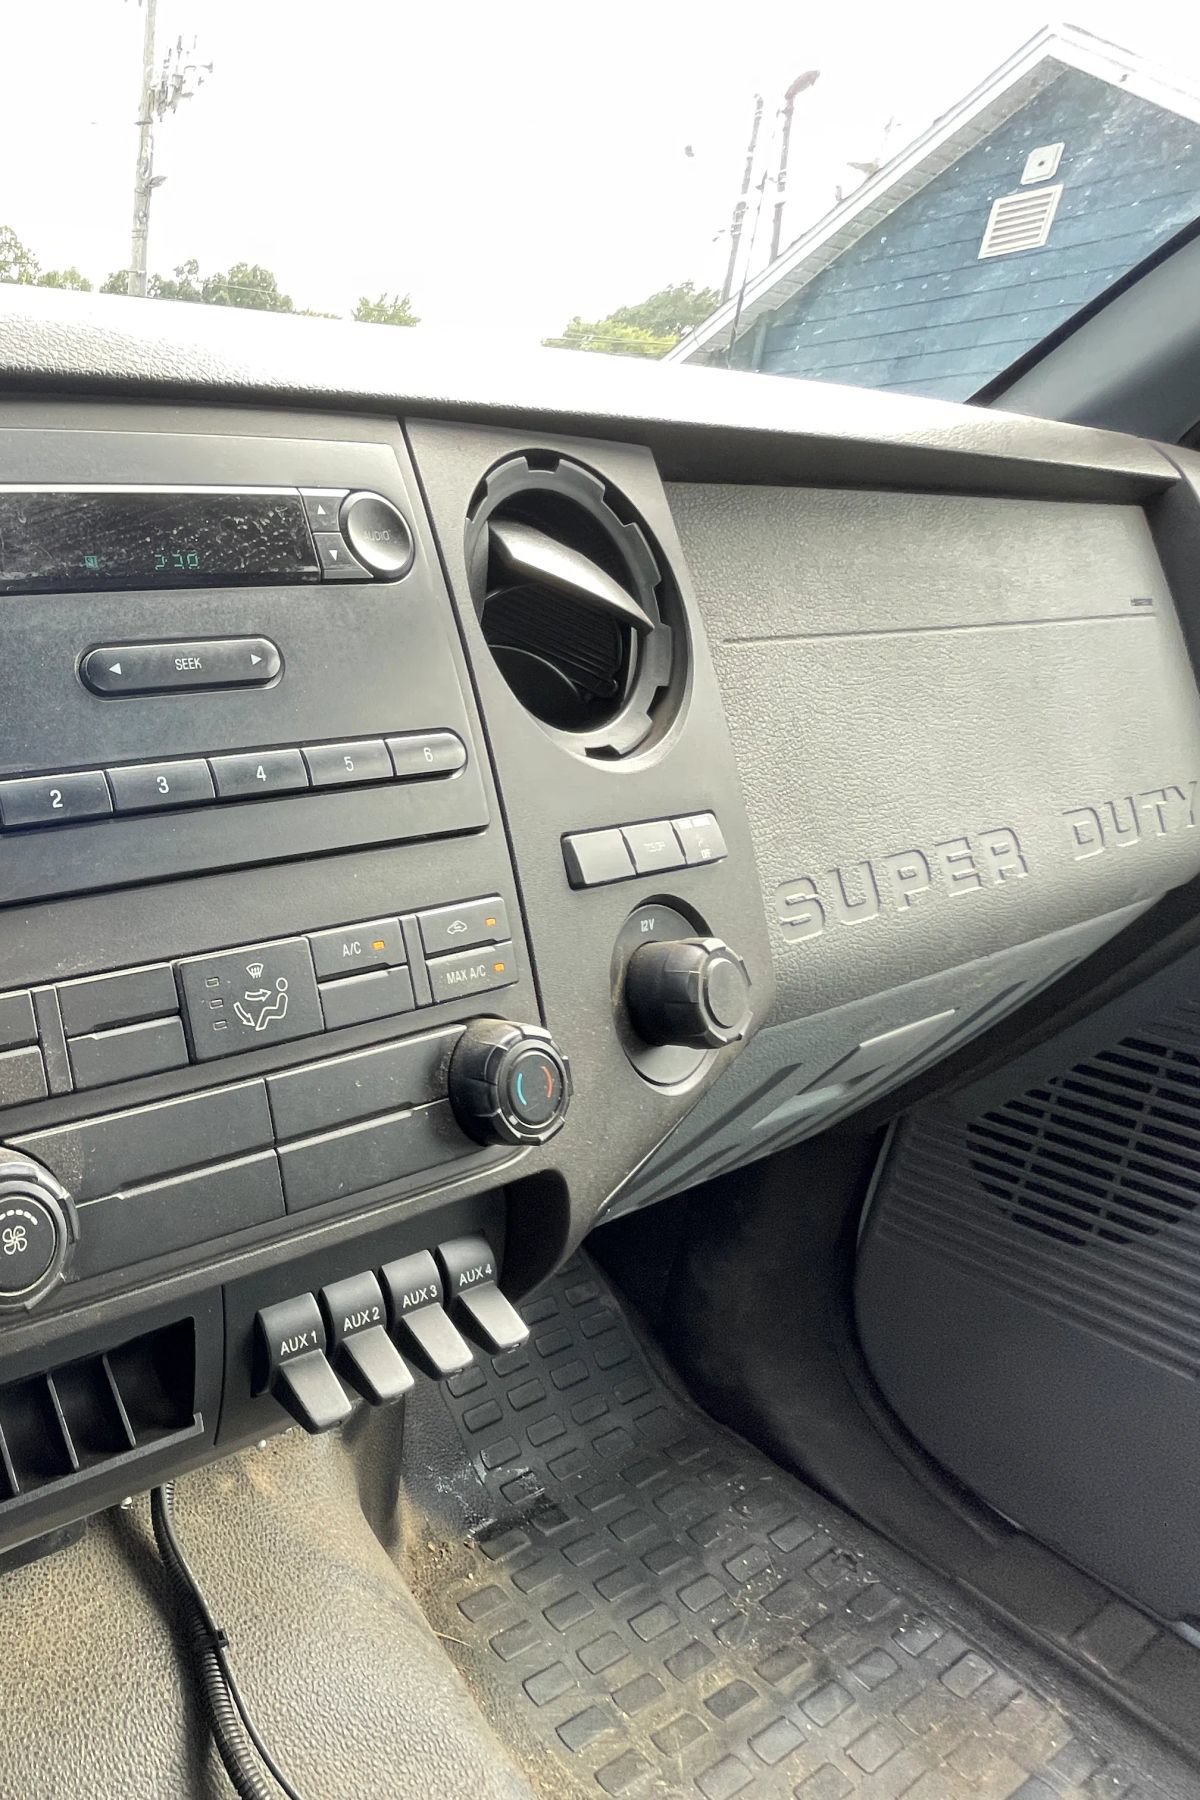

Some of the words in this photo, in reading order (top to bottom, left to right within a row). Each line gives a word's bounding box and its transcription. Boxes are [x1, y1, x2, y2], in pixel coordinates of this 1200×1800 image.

[174, 657, 202, 671] SEEK
[343, 756, 354, 772] 5
[423, 747, 433, 763] 6
[256, 765, 267, 782] 4
[156, 776, 170, 794] 3
[50, 789, 63, 808] 2
[774, 827, 1029, 944] SUPER
[1061, 780, 1198, 861] DUTY
[640, 917, 655, 933] 12V
[342, 941, 362, 957] A/C
[446, 972, 468, 985] MAX
[470, 965, 487, 980] A/C
[459, 1270, 484, 1287] AUX
[484, 1263, 493, 1276] 4
[402, 1288, 429, 1308] AUX
[429, 1284, 439, 1298] 3
[343, 1312, 371, 1332] AUX
[371, 1307, 381, 1320] 2
[280, 1334, 309, 1356] AUX
[310, 1330, 319, 1344] 1
